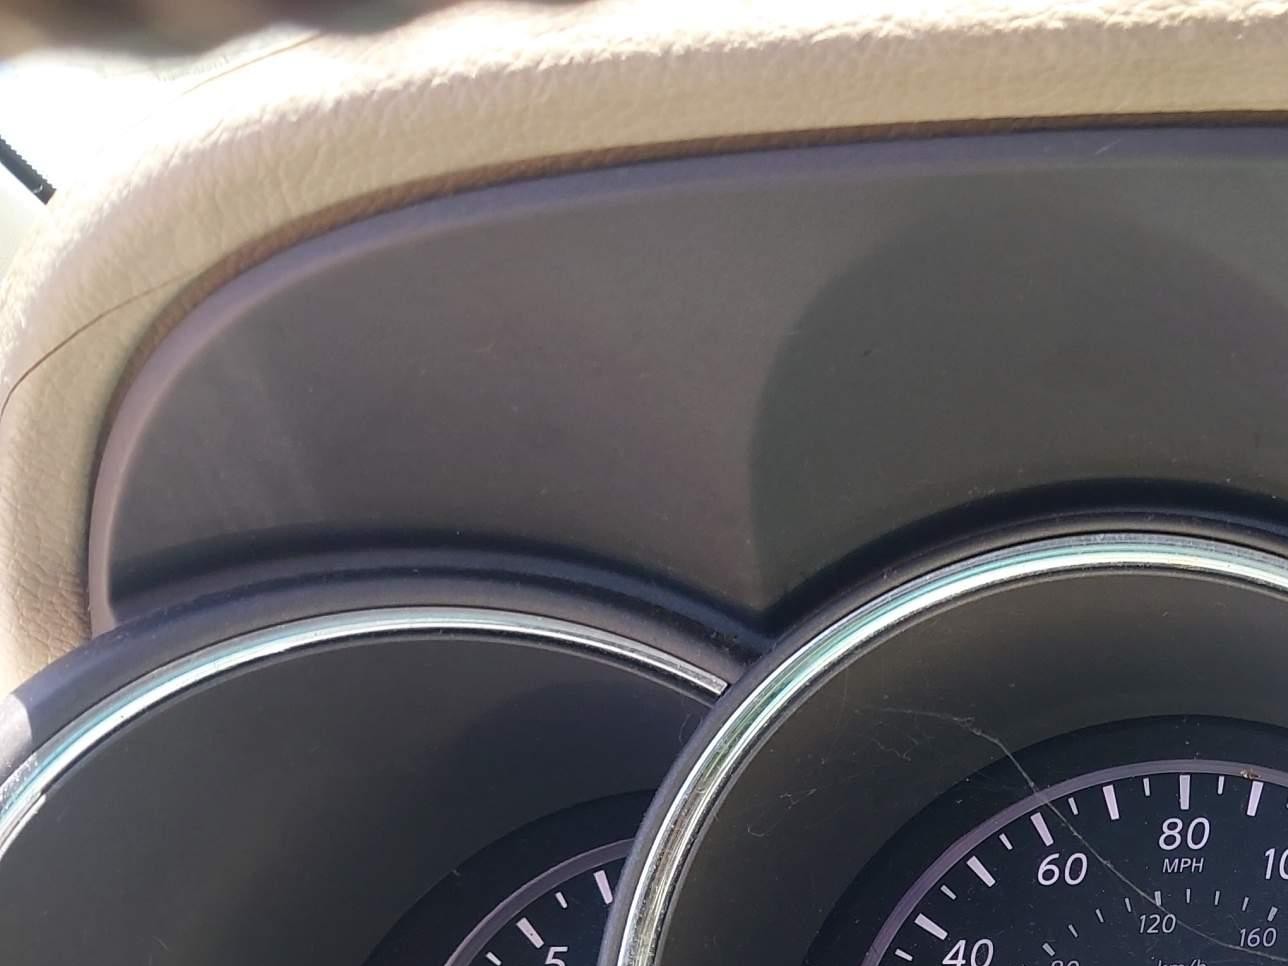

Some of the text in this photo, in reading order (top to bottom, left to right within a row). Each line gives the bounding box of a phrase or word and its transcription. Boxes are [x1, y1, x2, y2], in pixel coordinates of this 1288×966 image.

[1159, 818, 1209, 850] 80
[1038, 853, 1087, 885] 60
[1163, 858, 1203, 872] MPH
[1139, 914, 1177, 934] 120
[1241, 928, 1276, 947] 160
